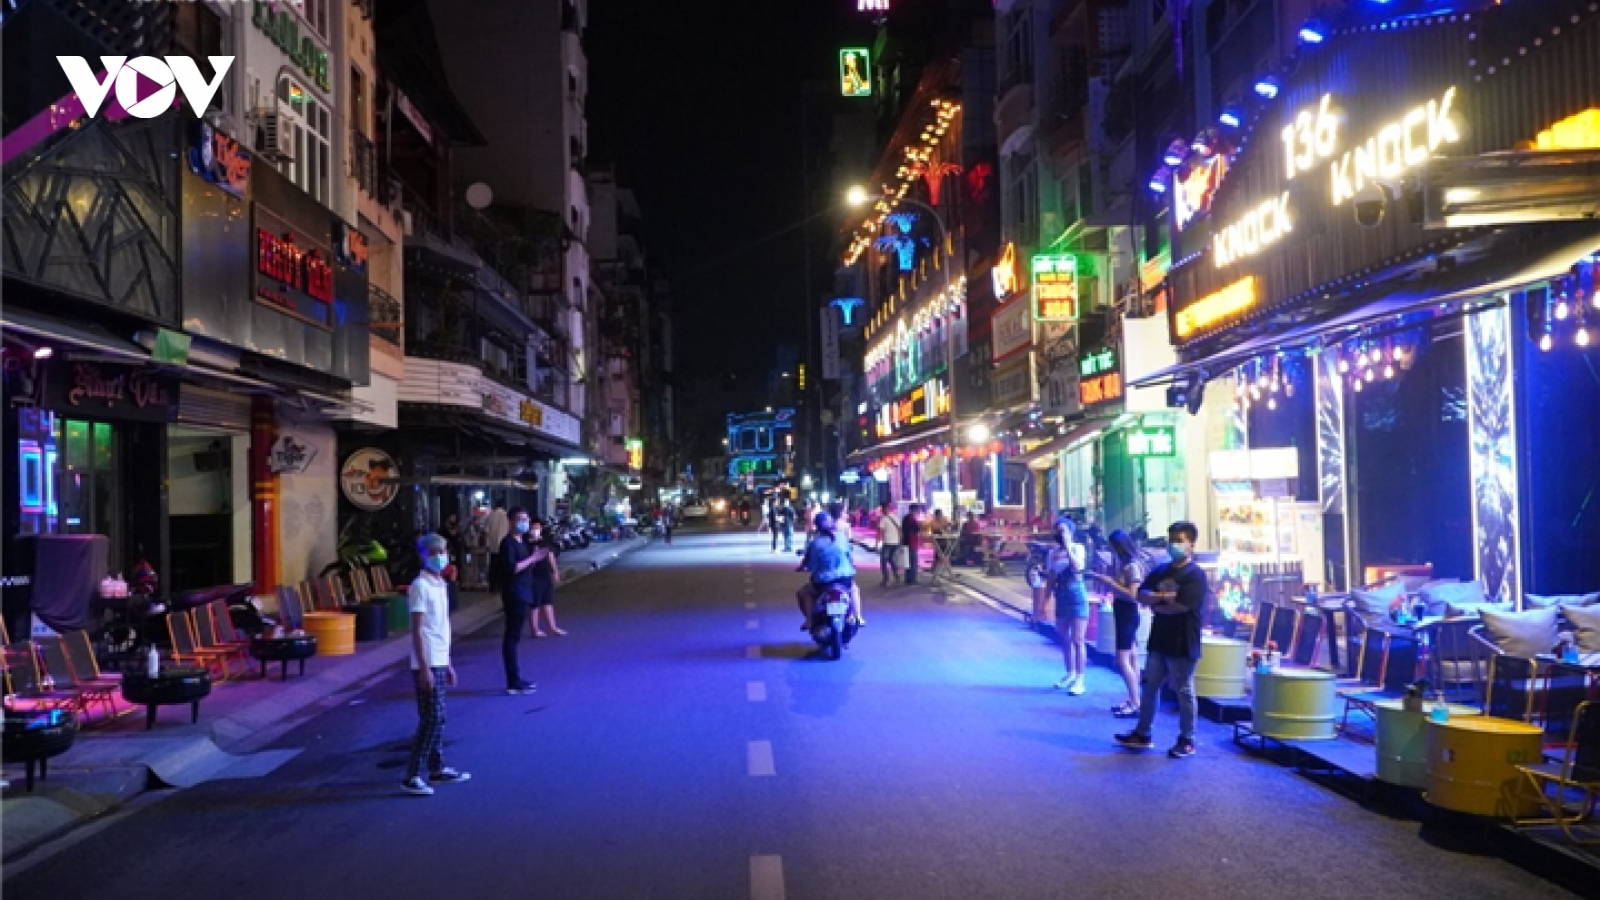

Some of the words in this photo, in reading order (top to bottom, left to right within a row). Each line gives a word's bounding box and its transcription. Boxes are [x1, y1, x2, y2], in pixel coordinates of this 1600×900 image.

[1214, 191, 1292, 267] KNOCK
[1331, 86, 1459, 205] KNOCK
[1282, 94, 1338, 179] 136
